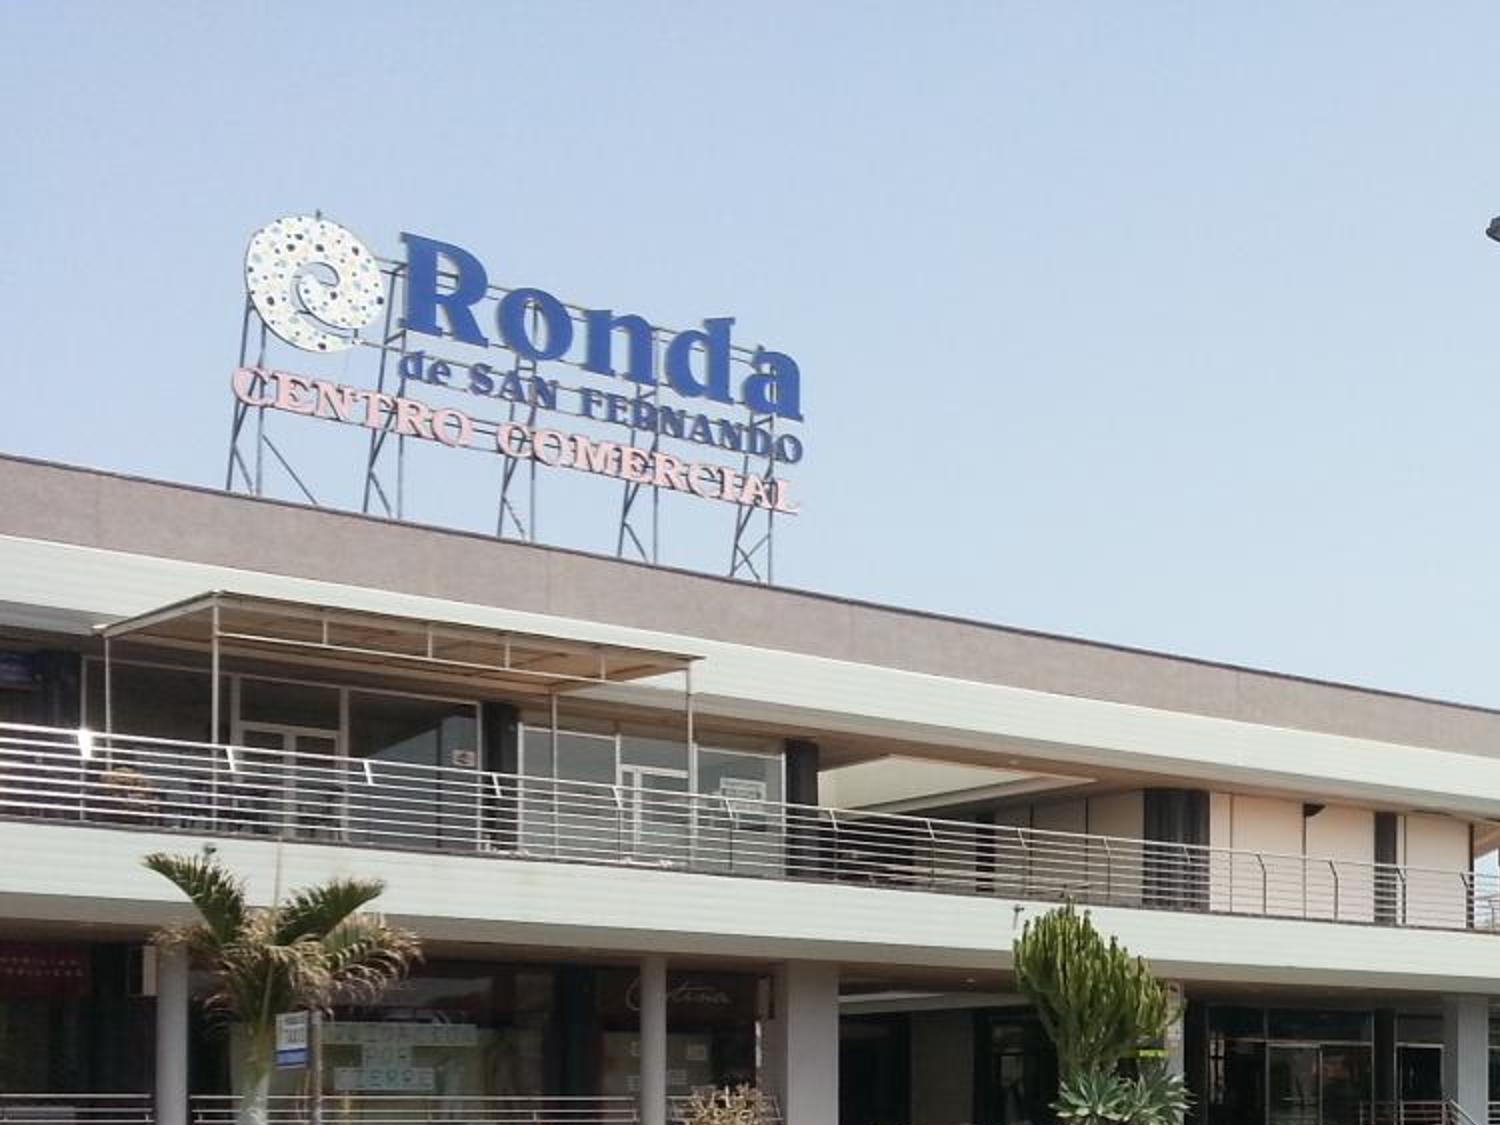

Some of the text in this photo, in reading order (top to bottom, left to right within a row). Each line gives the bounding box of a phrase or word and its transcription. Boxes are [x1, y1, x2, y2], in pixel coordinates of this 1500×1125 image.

[399, 231, 804, 423] Ronda
[231, 367, 800, 515] CENTRO COMERCIAL
[399, 350, 804, 465] de SAN FERNANDO
